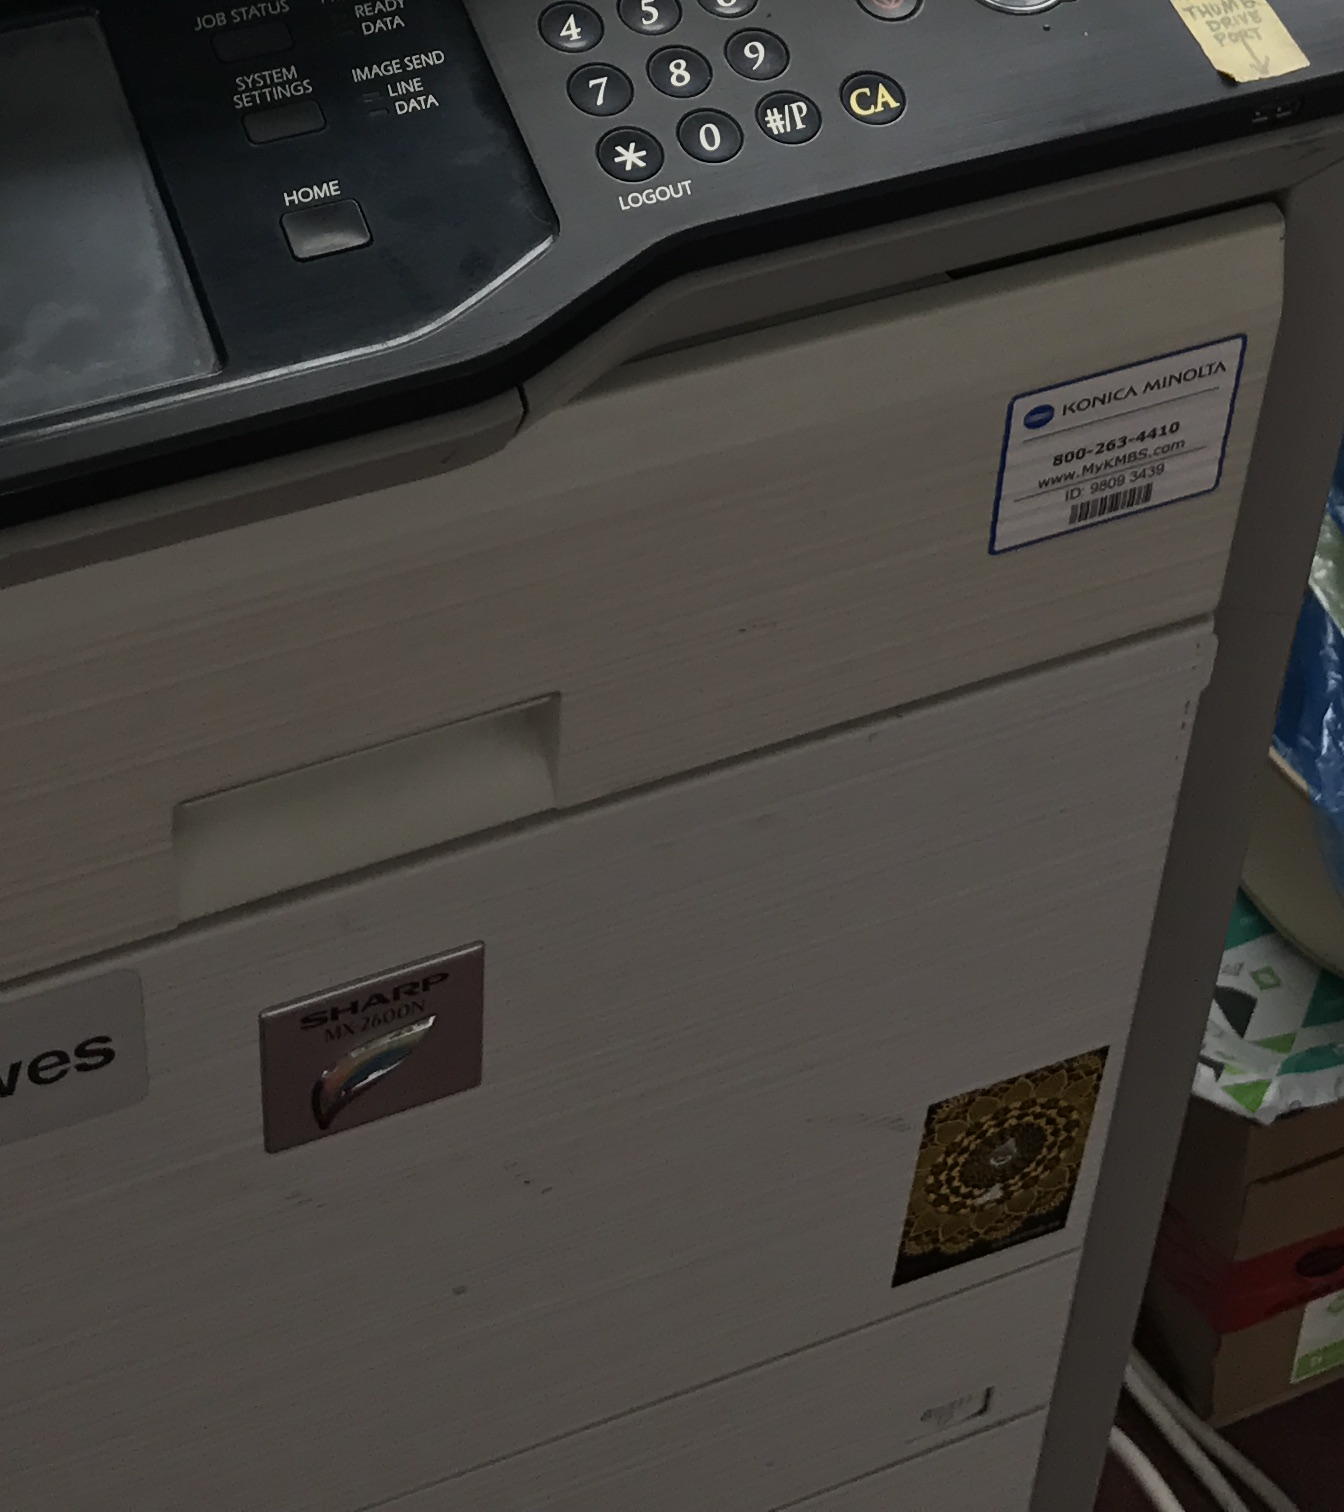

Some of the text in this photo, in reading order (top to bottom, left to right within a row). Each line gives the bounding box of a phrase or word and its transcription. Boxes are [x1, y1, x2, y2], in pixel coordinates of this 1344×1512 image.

[193, 12, 229, 34] JOB
[360, 14, 407, 37] DATA
[559, 13, 582, 43] 4
[1203, 10, 1265, 34] DRIVE
[351, 48, 446, 84] IMAGE SEND
[743, 41, 765, 71] 9
[234, 65, 299, 92] SYSTEM
[386, 75, 425, 98] LINE
[667, 58, 691, 87] 8
[232, 79, 314, 110] SETTINGS
[394, 93, 441, 117] DATA
[587, 76, 611, 106] 7
[848, 83, 901, 117] CA
[763, 99, 809, 135] #/P
[698, 122, 721, 151] 0
[282, 180, 342, 207] HOME
[617, 179, 694, 211] LOGOUT
[1061, 360, 1228, 417] KONICA MINOLTA
[1051, 420, 1181, 467] 800-263-4410
[299, 972, 450, 1033] SHARP
